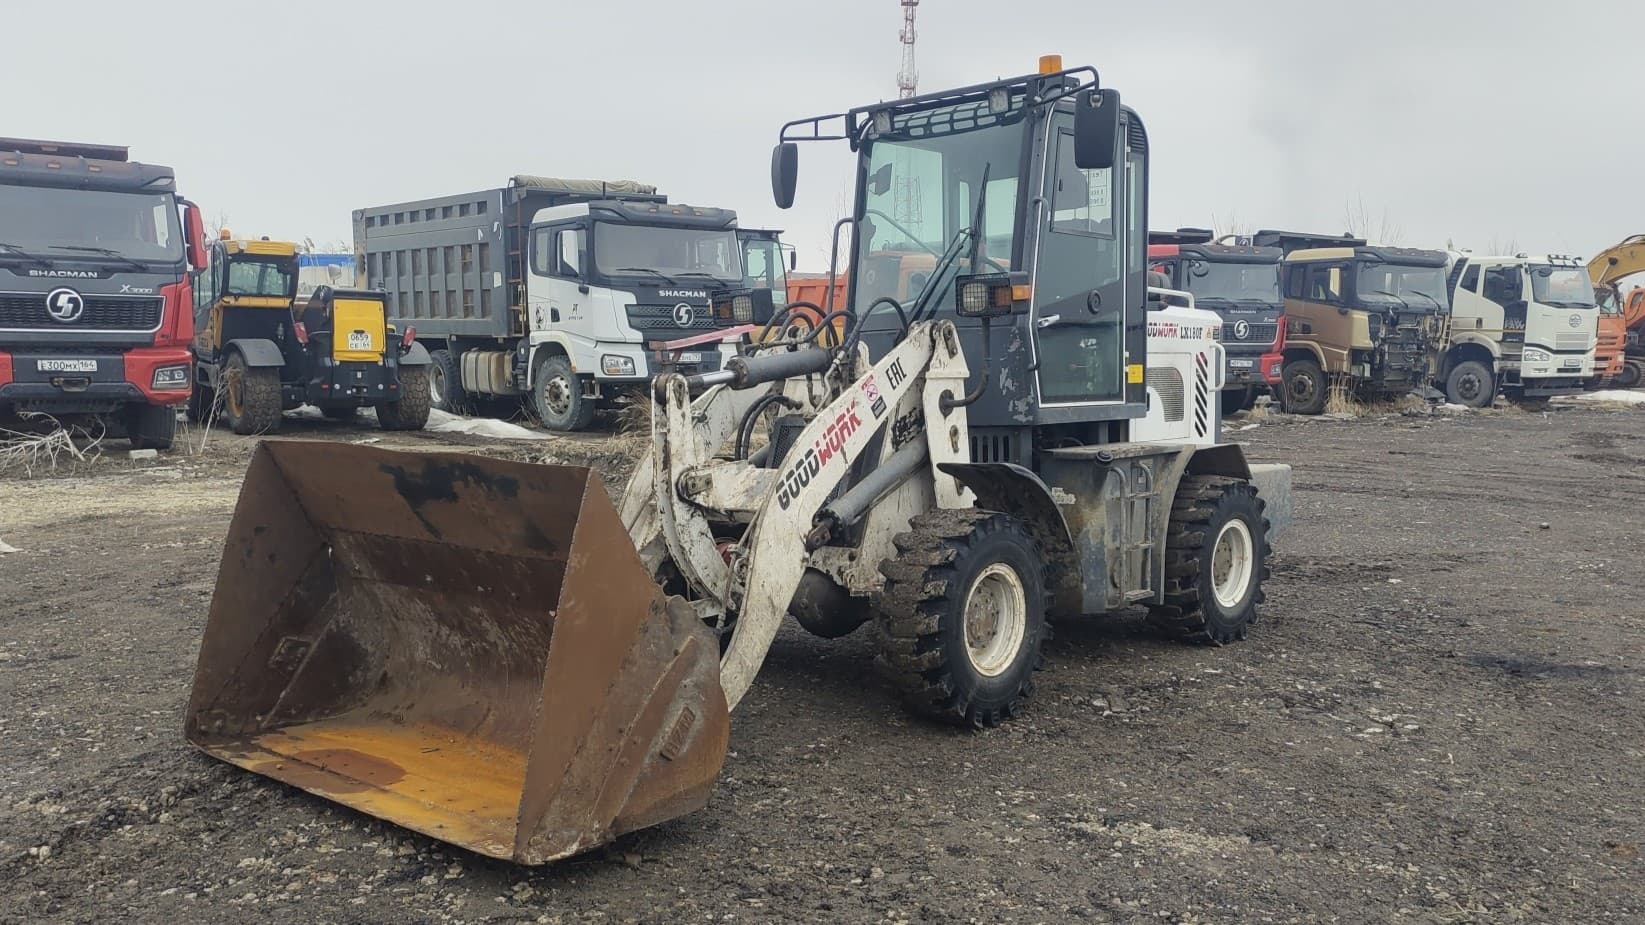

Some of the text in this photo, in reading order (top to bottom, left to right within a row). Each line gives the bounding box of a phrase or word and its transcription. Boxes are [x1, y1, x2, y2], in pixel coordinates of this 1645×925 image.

[28, 270, 98, 279] SHACMAN
[120, 283, 153, 294] X3000
[658, 289, 707, 298] SHACMAN
[1504, 317, 1525, 329] FAW
[776, 399, 861, 511] GOODWORK
